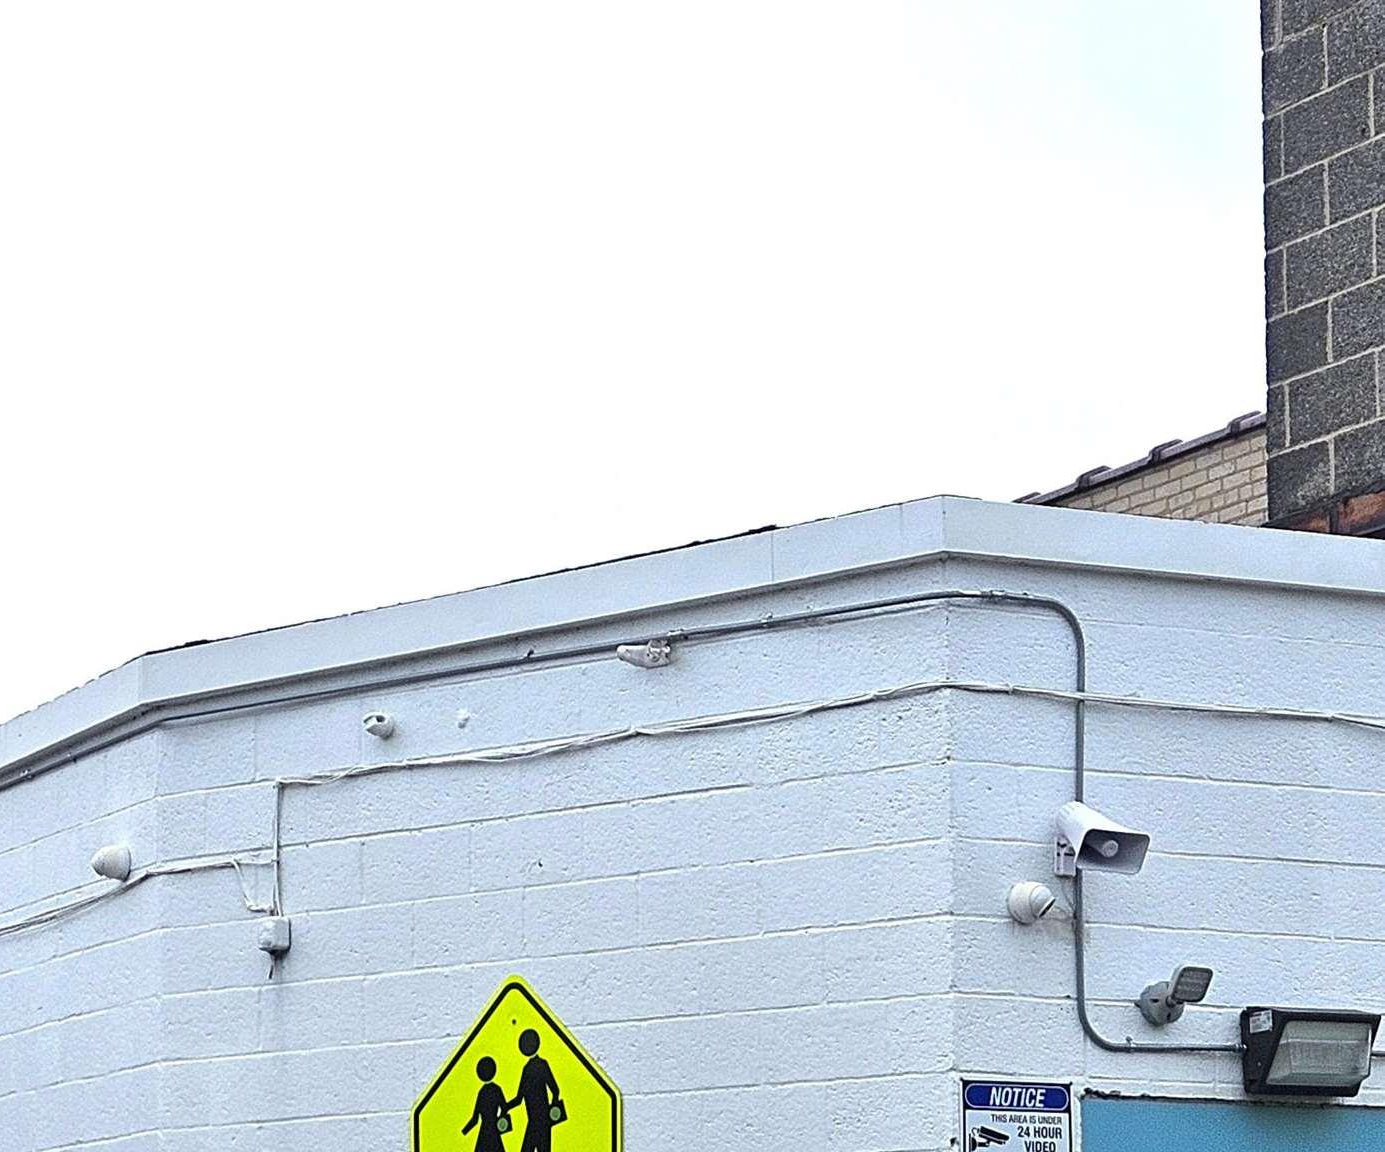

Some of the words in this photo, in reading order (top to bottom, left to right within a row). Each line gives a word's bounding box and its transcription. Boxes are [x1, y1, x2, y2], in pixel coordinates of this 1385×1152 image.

[989, 1086, 1046, 1108] NOTICE
[991, 1113, 1008, 1123] THIS
[1008, 1114, 1028, 1124] AREA
[1029, 1115, 1037, 1124] IS
[1037, 1115, 1062, 1125] UNDER
[1017, 1125, 1030, 1138] 24
[1033, 1126, 1063, 1139] HOUR
[1024, 1140, 1056, 1152] VIDEO
